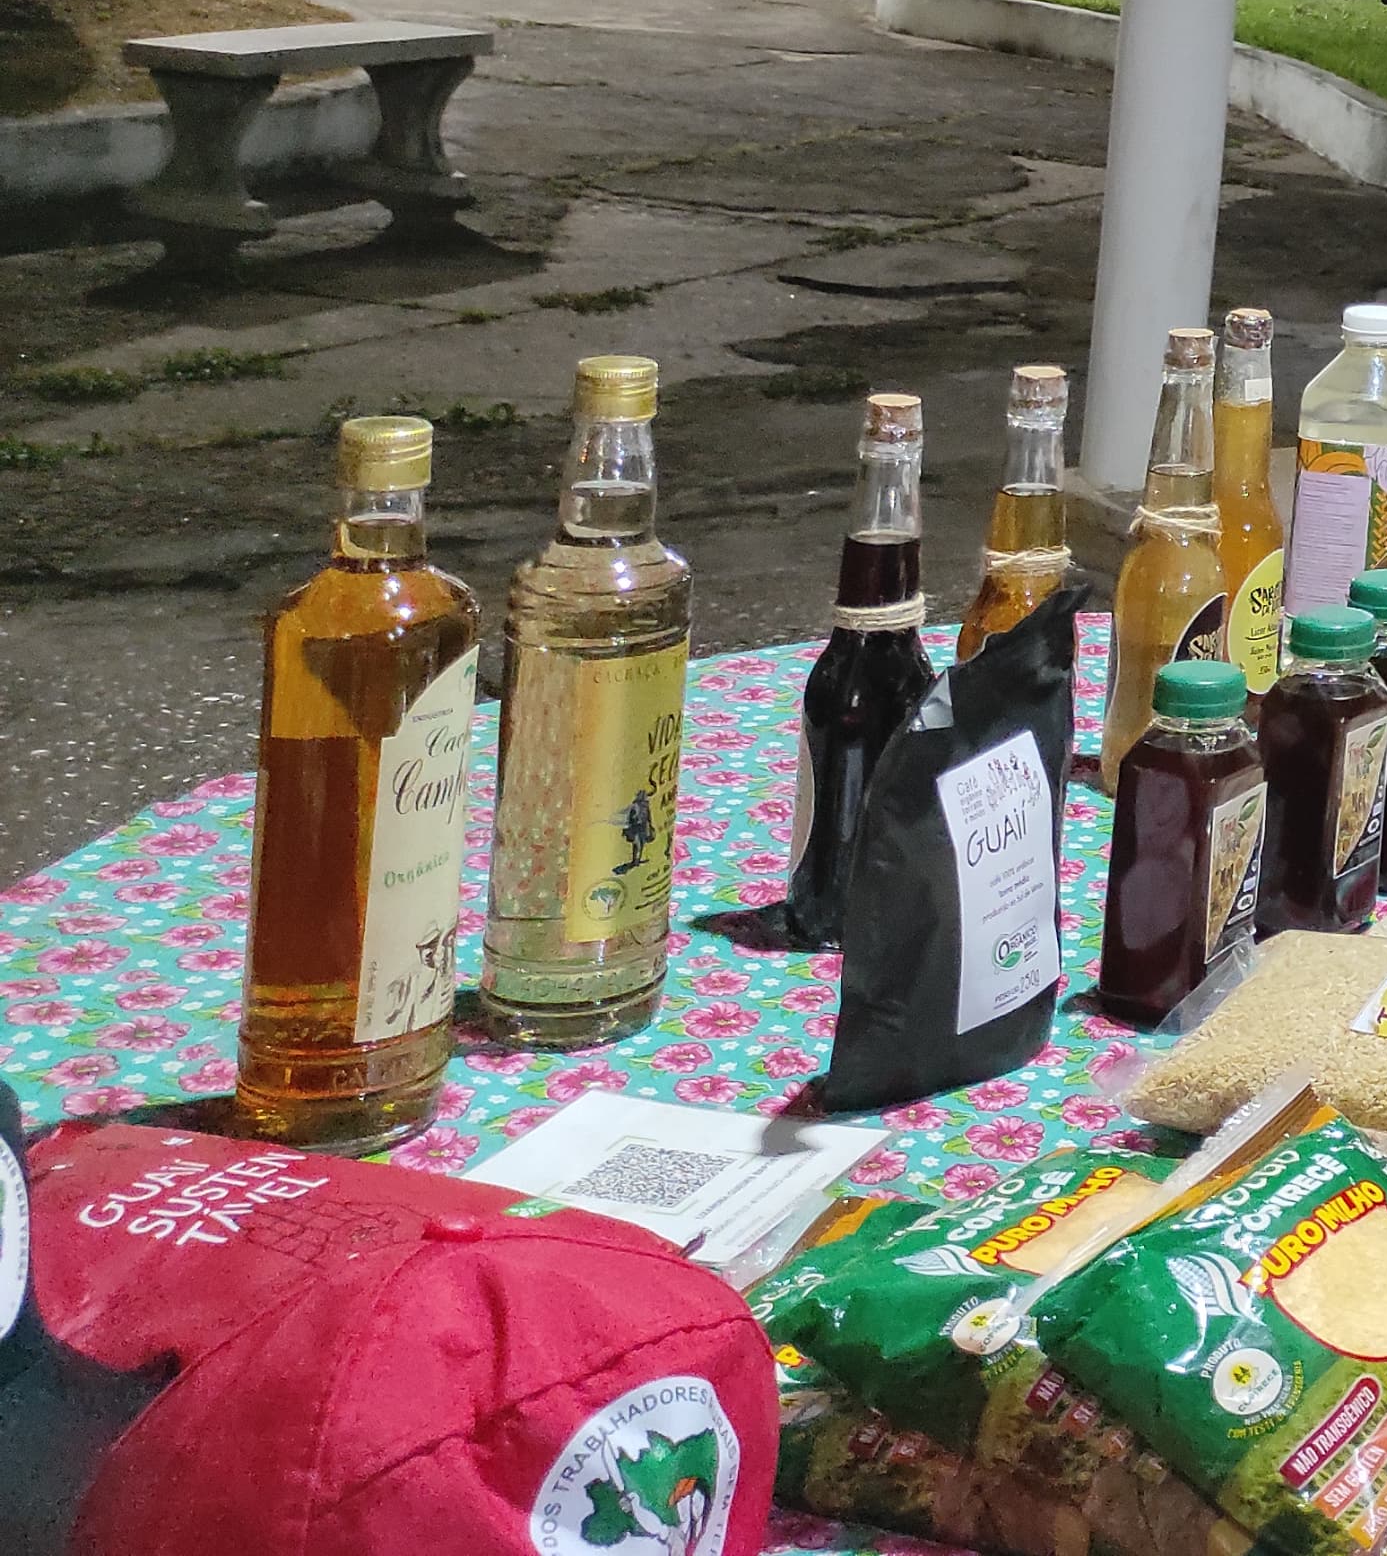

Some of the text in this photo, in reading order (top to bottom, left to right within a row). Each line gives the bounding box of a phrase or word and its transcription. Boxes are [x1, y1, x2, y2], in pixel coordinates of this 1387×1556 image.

[127, 1152, 307, 1240] SUSTEN
[970, 1214, 1052, 1266] PURO
[1241, 1180, 1385, 1293] PURO MILHO
[1200, 1338, 1242, 1379] PRODUTO
[1291, 1445, 1319, 1476] NÃO
[1314, 1385, 1376, 1456] TRANSGÊNICO
[1323, 1444, 1387, 1509] SEM GTEN
[541, 1501, 563, 1549] DOS
